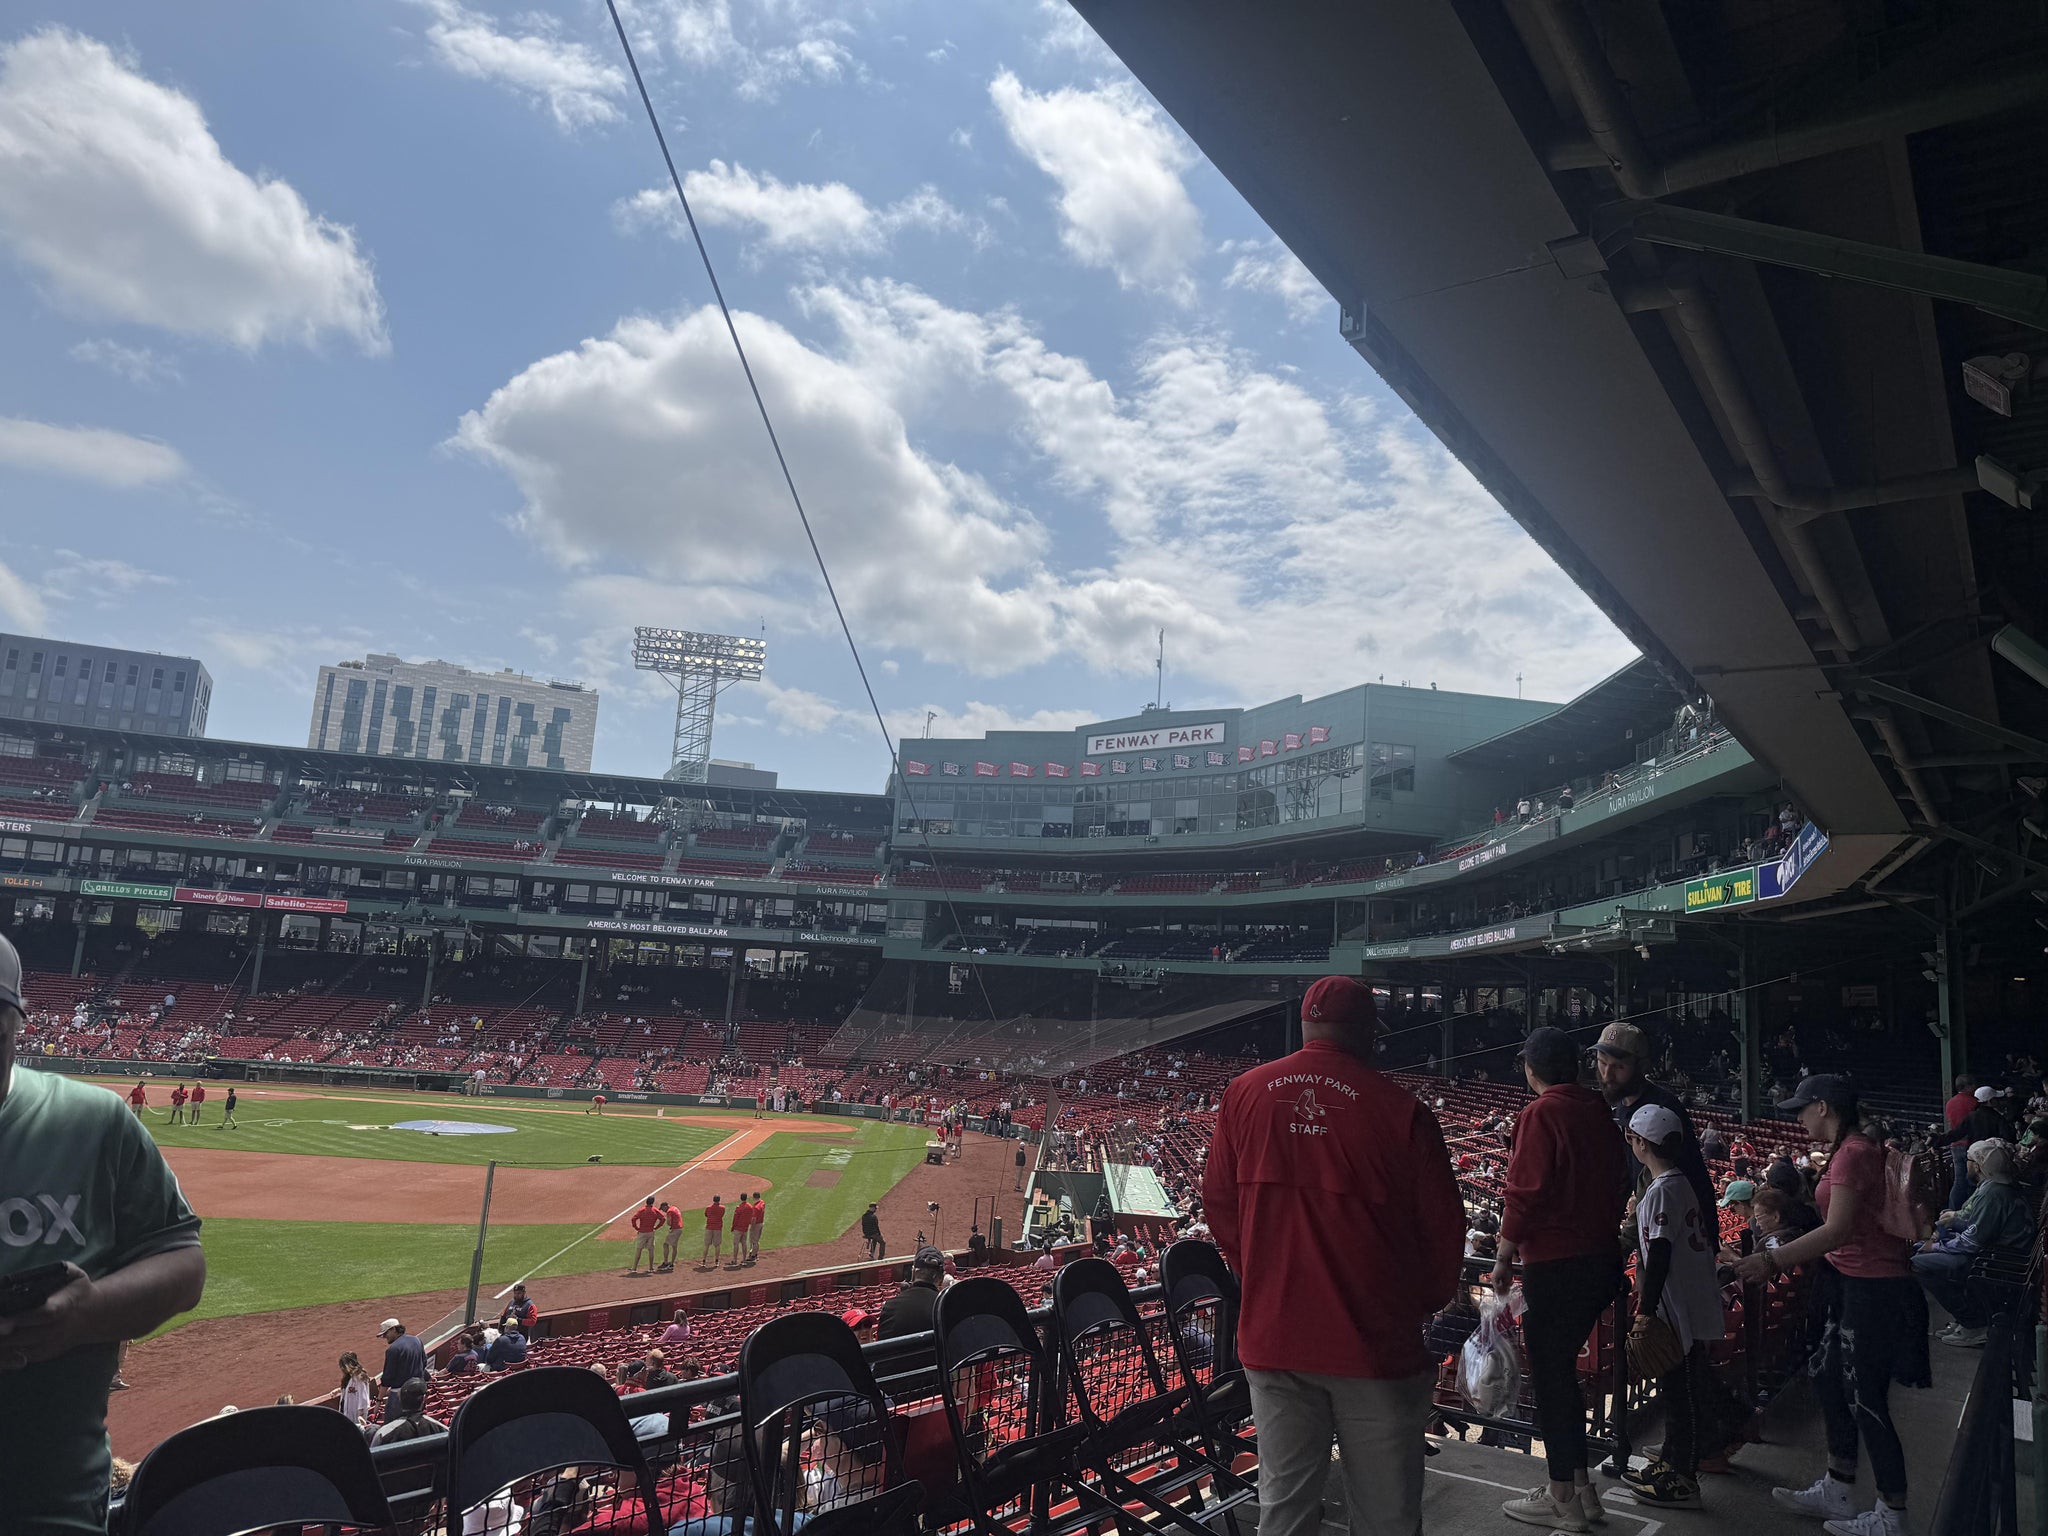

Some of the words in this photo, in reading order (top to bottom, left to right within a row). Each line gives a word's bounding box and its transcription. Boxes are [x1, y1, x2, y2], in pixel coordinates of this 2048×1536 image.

[1095, 733, 1160, 751] FENWAY
[1169, 727, 1214, 744] PARK
[429, 859, 462, 868] PAVILION
[611, 873, 647, 882] WELCOME
[650, 875, 659, 883] TO
[661, 876, 692, 885] FENWAY
[694, 879, 715, 887] PARK
[95, 885, 130, 894] GRILLO'S
[134, 887, 169, 897] PICKLES
[192, 892, 216, 901] Ninety
[228, 895, 245, 903] Nine
[838, 887, 869, 896] PAVILION
[1687, 883, 1723, 907] SULLIVAN
[1733, 879, 1752, 898] TIRE
[267, 899, 306, 908] Safelite
[587, 920, 628, 930] AMERICA'S
[630, 923, 651, 931] MOST
[652, 924, 687, 934] BELOVED
[689, 927, 729, 937] BALLPARK
[800, 932, 820, 941] DELL
[820, 934, 859, 944] Technologies
[859, 936, 877, 944] Level
[1267, 1073, 1323, 1092] FENWAY
[1324, 1077, 1360, 1102] PARK
[1289, 1122, 1328, 1136] STAFF
